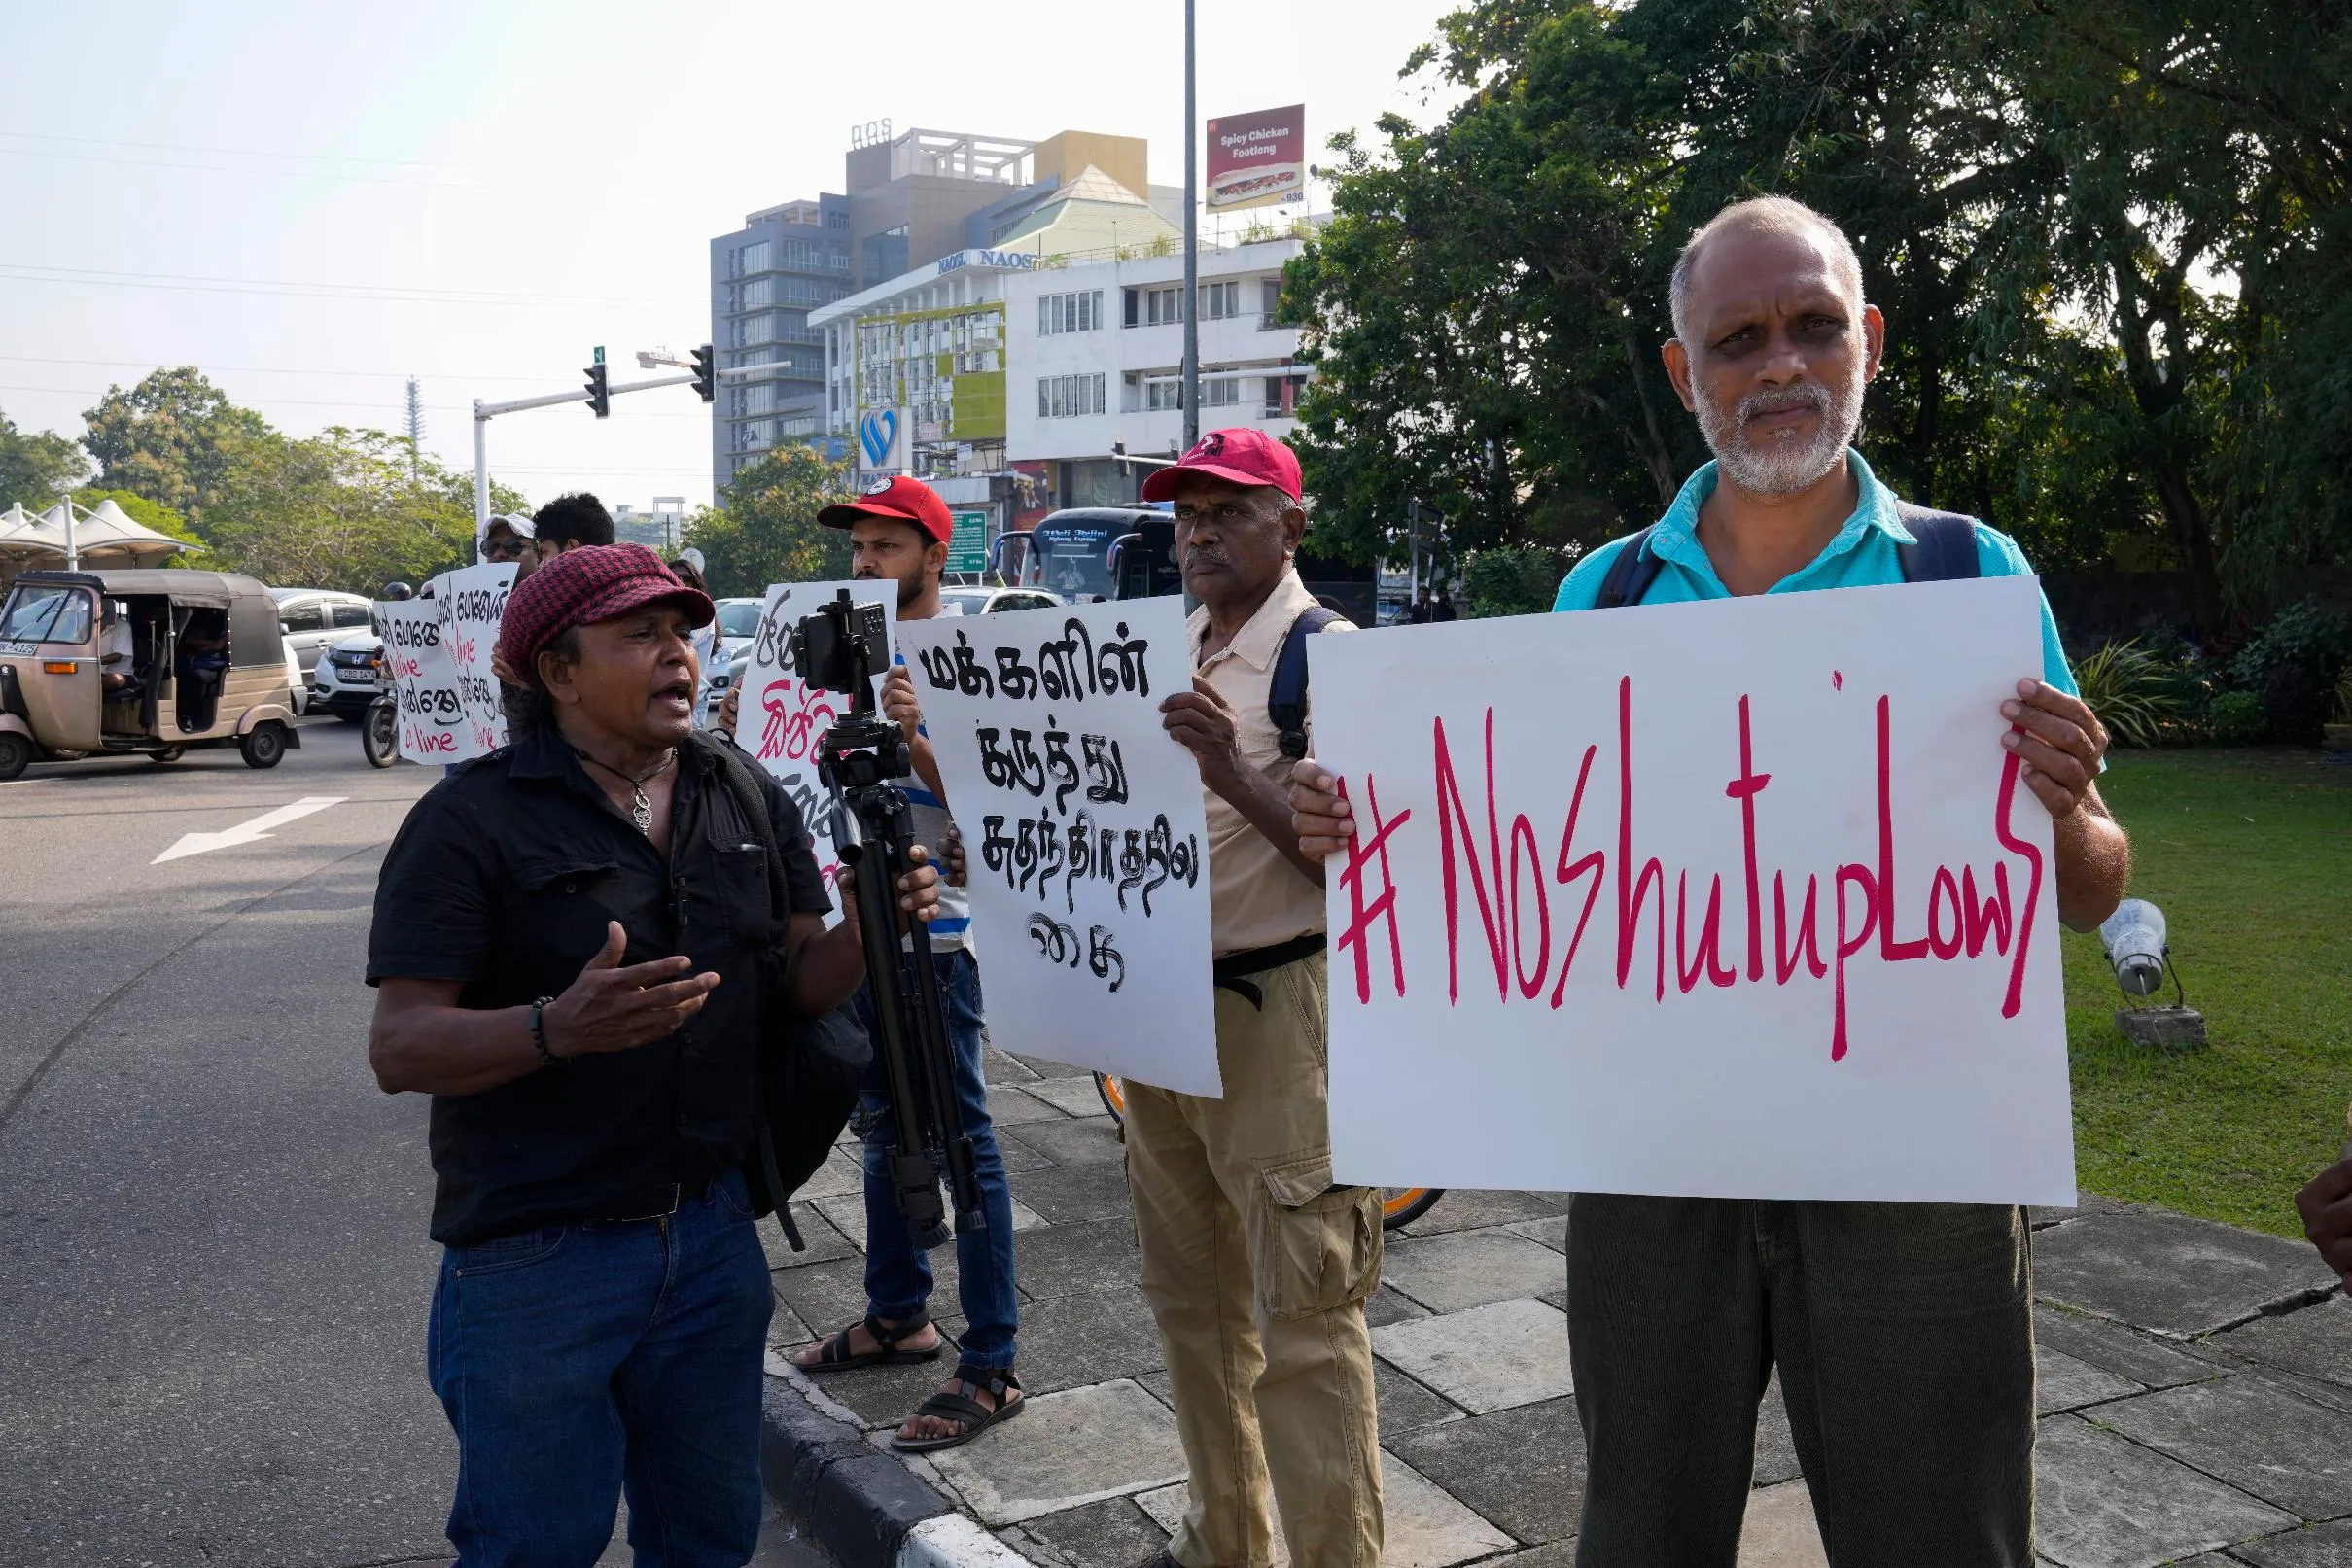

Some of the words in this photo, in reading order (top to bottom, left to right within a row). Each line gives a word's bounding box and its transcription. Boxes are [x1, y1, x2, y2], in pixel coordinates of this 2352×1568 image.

[1221, 134, 1246, 147] Spicy
[1249, 127, 1289, 141] Chicken
[1233, 144, 1276, 157] Footlong
[918, 617, 1150, 703] மக்களின்
[976, 714, 1129, 817] கருத்து
